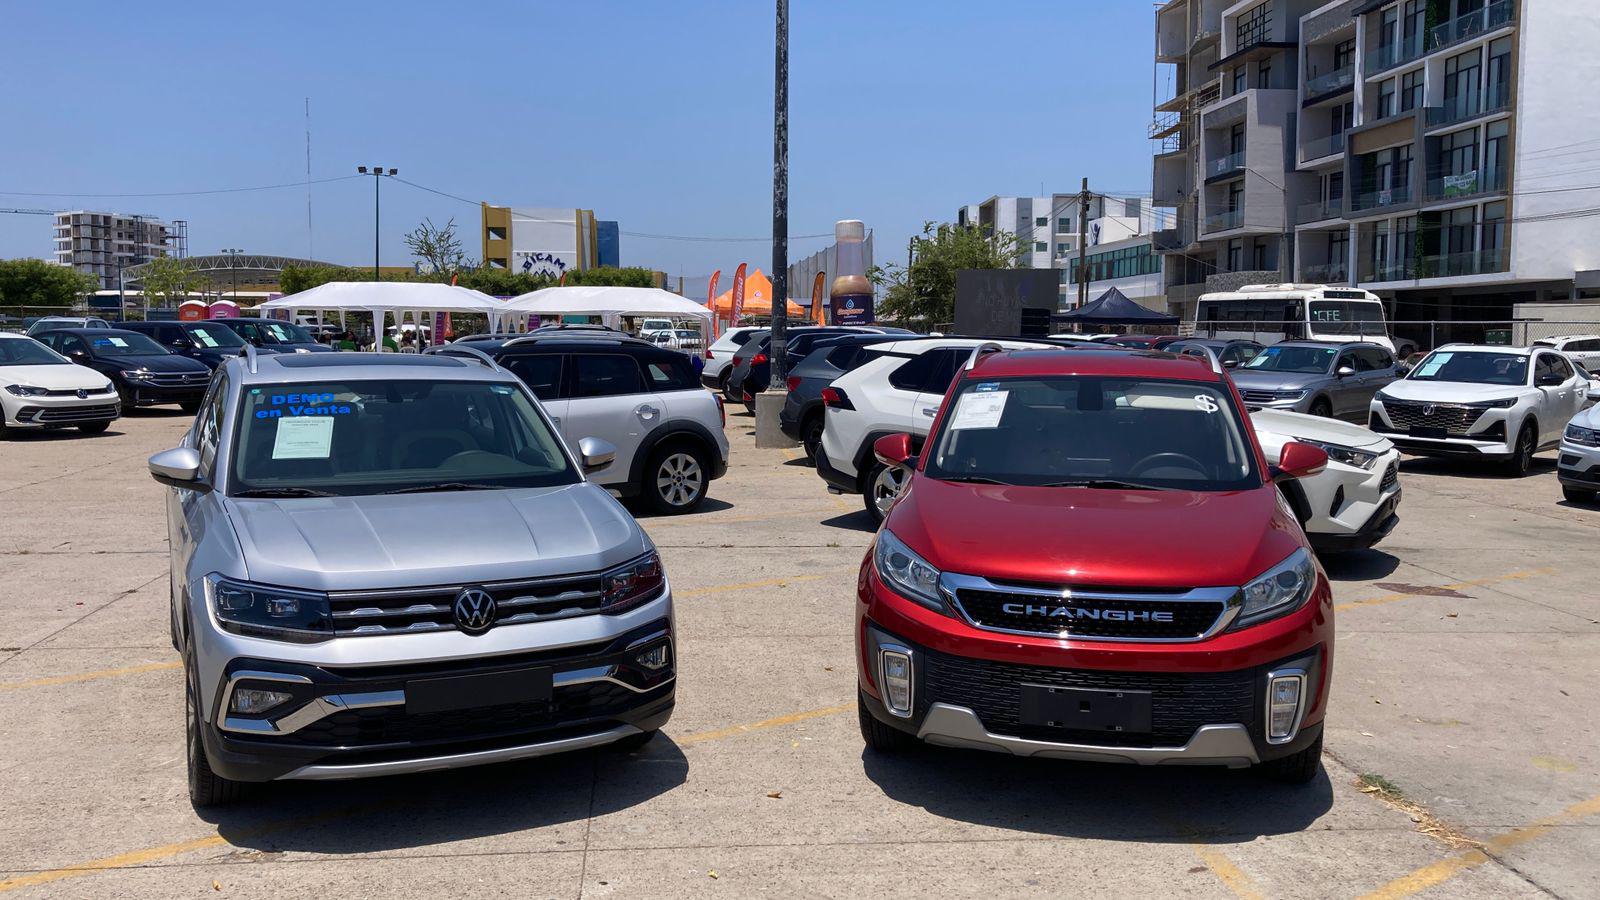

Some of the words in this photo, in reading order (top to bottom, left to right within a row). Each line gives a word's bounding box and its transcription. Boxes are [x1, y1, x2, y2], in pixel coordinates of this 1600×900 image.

[522, 253, 566, 271] BICAM
[272, 393, 334, 405] DEMO
[256, 408, 282, 419] en
[289, 404, 350, 416] Venta
[1003, 603, 1173, 622] CHANGHE
